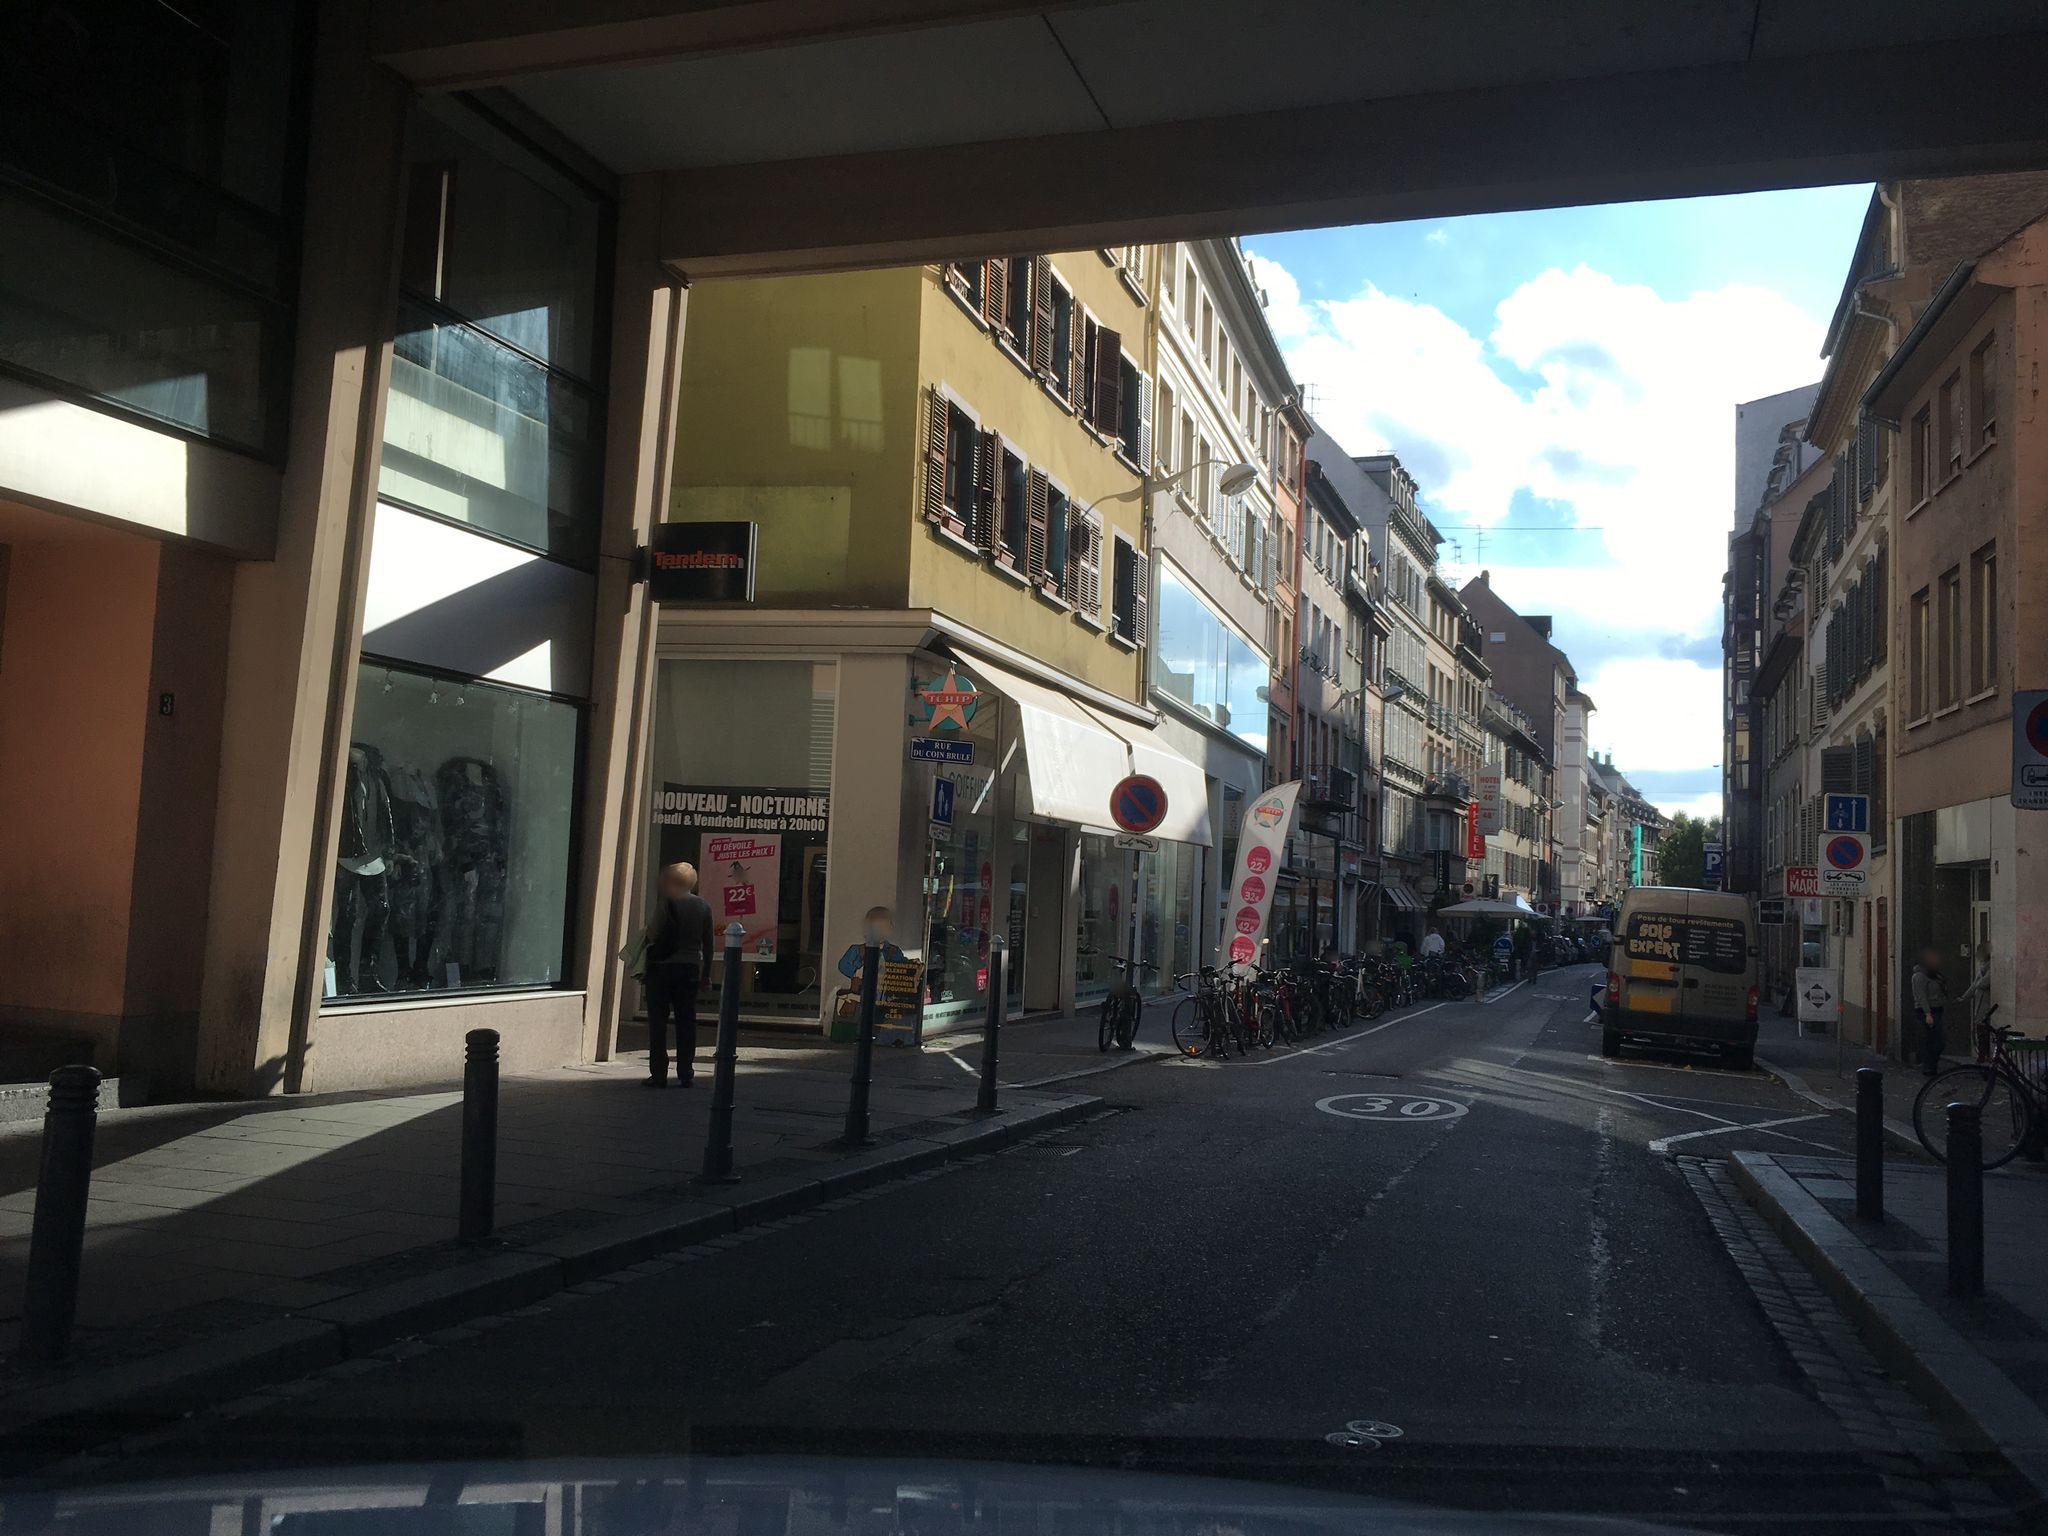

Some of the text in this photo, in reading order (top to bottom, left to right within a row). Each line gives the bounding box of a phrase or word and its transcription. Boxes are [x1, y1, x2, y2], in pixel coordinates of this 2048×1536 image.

[654, 548, 744, 570] Tandem
[928, 695, 971, 704] TCHIP
[913, 749, 972, 761] DU COIN BRULE
[934, 742, 952, 751] RUE
[653, 791, 728, 813] NOUVEAU
[740, 795, 828, 817] NOCTURNE
[652, 811, 826, 832] Jeudi & Vendredi jusqu'à 20h00
[728, 886, 752, 902] 22€
[1637, 914, 1656, 922] Pose
[1669, 917, 1686, 925] tous
[1630, 939, 1681, 960] EXPERT
[1351, 1097, 1440, 1117] 30
